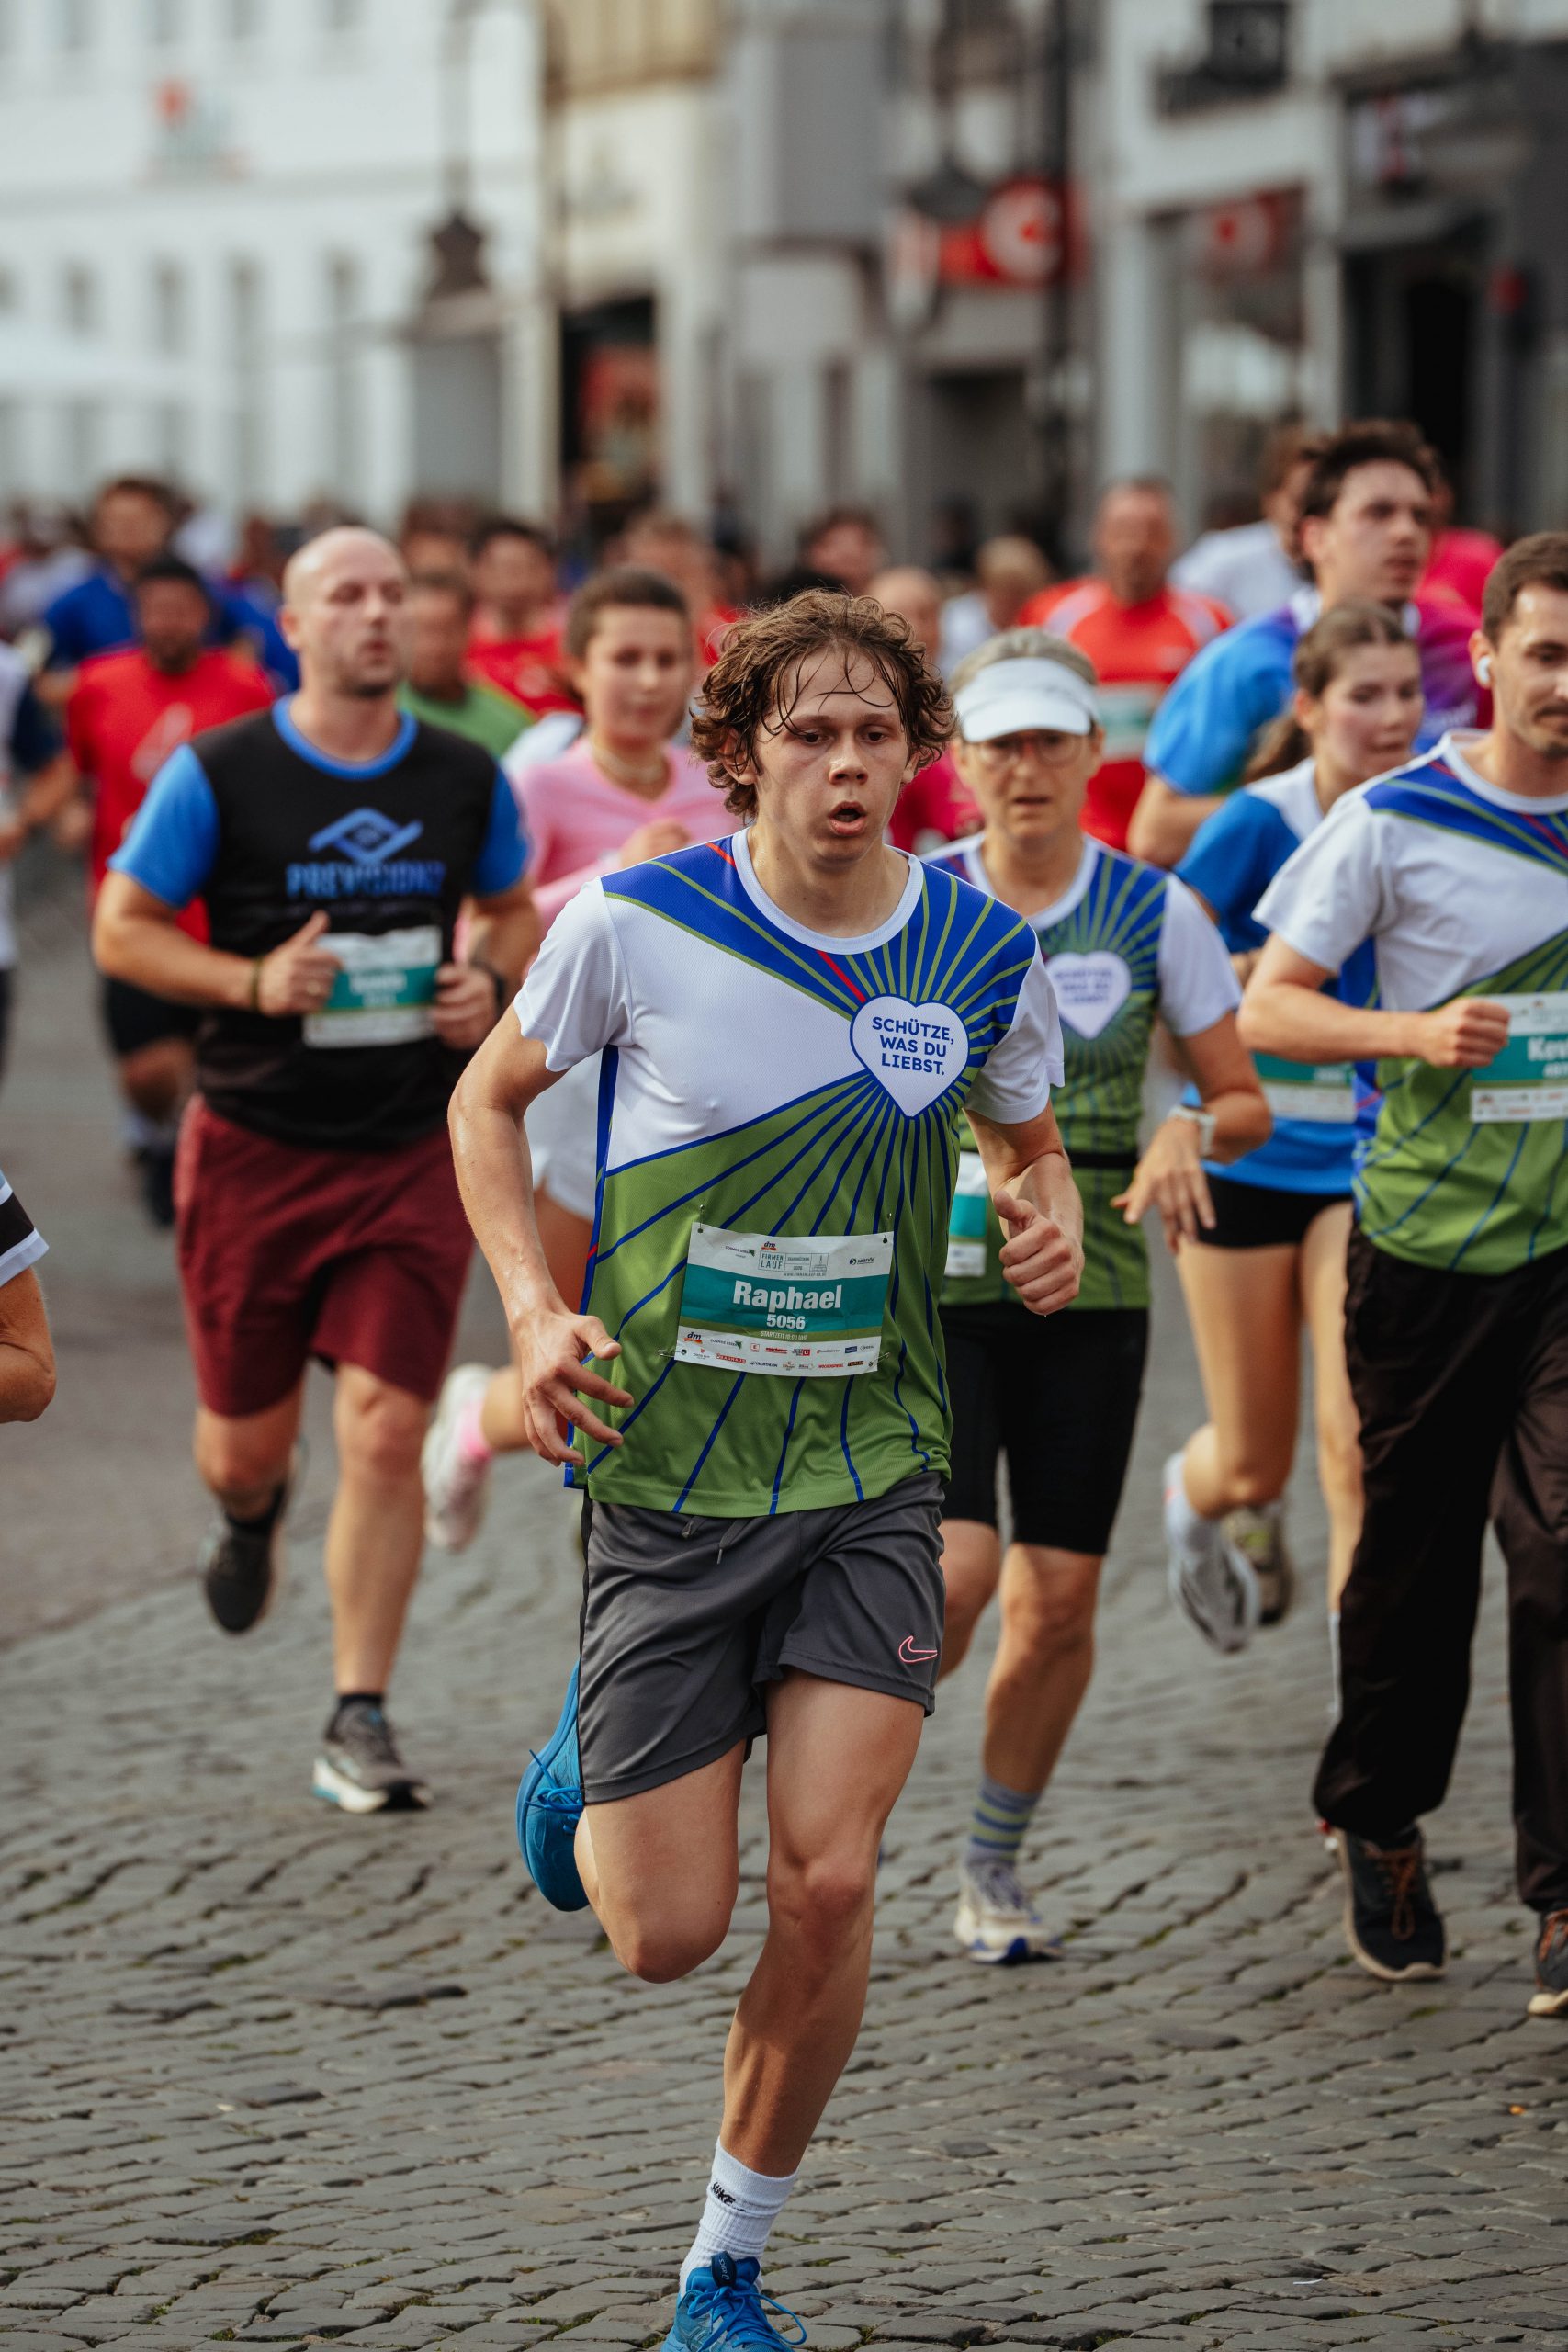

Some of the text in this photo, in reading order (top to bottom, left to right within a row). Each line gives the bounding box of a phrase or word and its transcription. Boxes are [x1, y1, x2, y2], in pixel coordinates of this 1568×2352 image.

[872, 1016, 954, 1045] SCHÜTZE,
[879, 1035, 947, 1057] WAS DU
[881, 1052, 945, 1076] LIEBST.
[764, 1240, 776, 1250] dm
[761, 1252, 784, 1261] FIRMEN
[761, 1260, 784, 1270] LAUF
[732, 1280, 842, 1313] Raphael
[766, 1313, 806, 1330] 5056
[687, 1331, 701, 1340] dm
